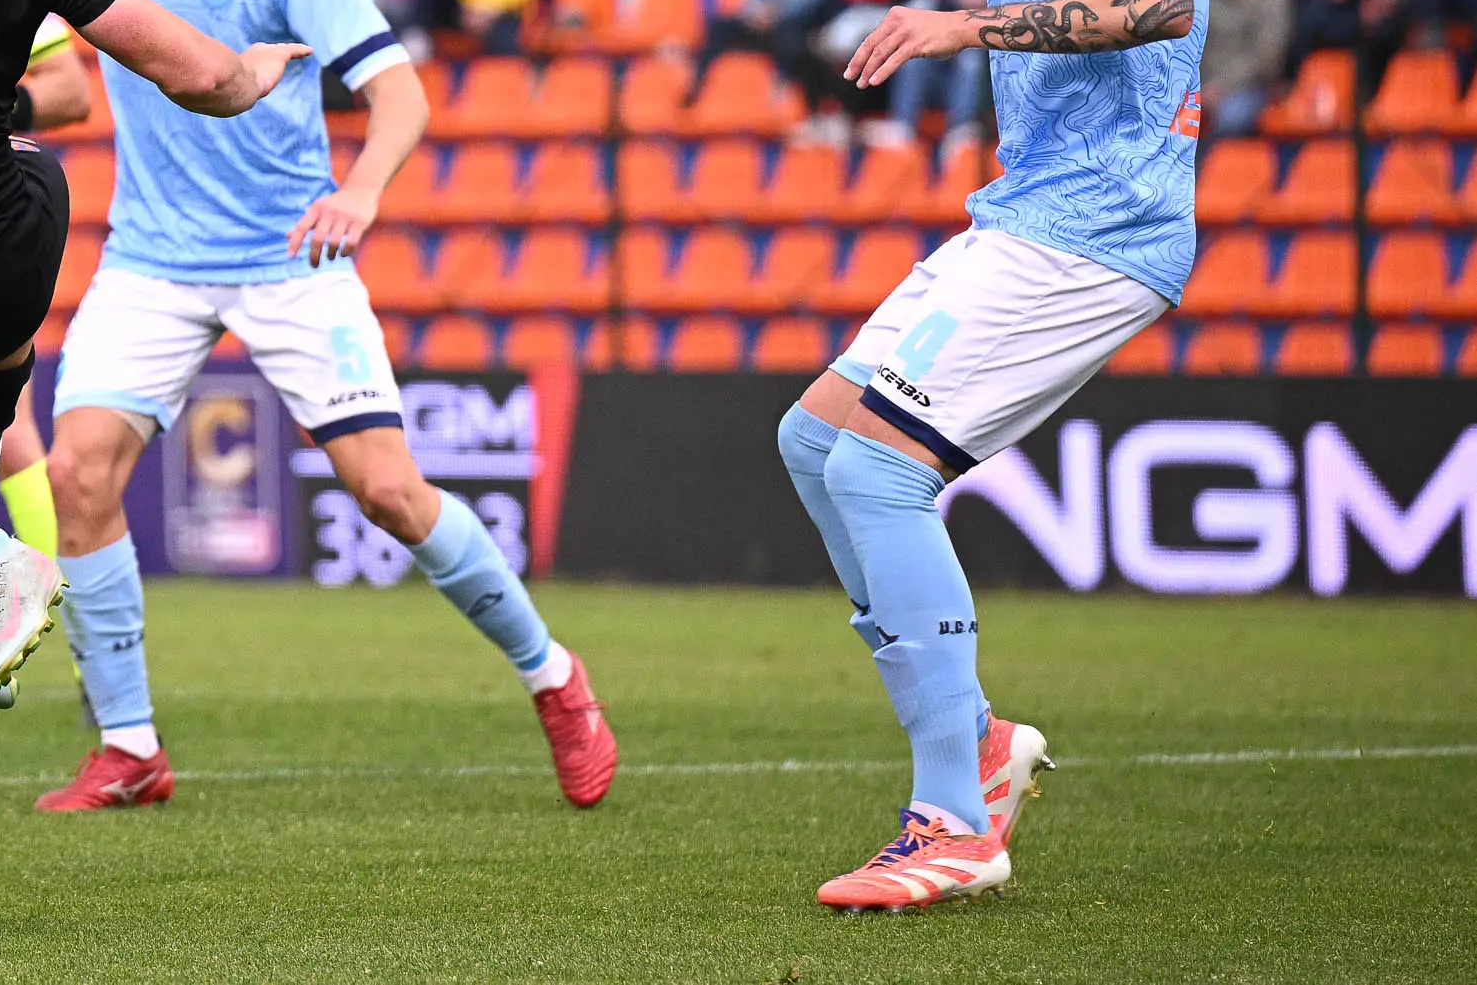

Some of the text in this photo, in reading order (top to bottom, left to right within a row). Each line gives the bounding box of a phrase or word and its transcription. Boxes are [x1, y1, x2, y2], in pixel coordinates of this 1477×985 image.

[329, 325, 371, 386] 5
[894, 310, 960, 382] 4
[938, 418, 1477, 598] NGM
